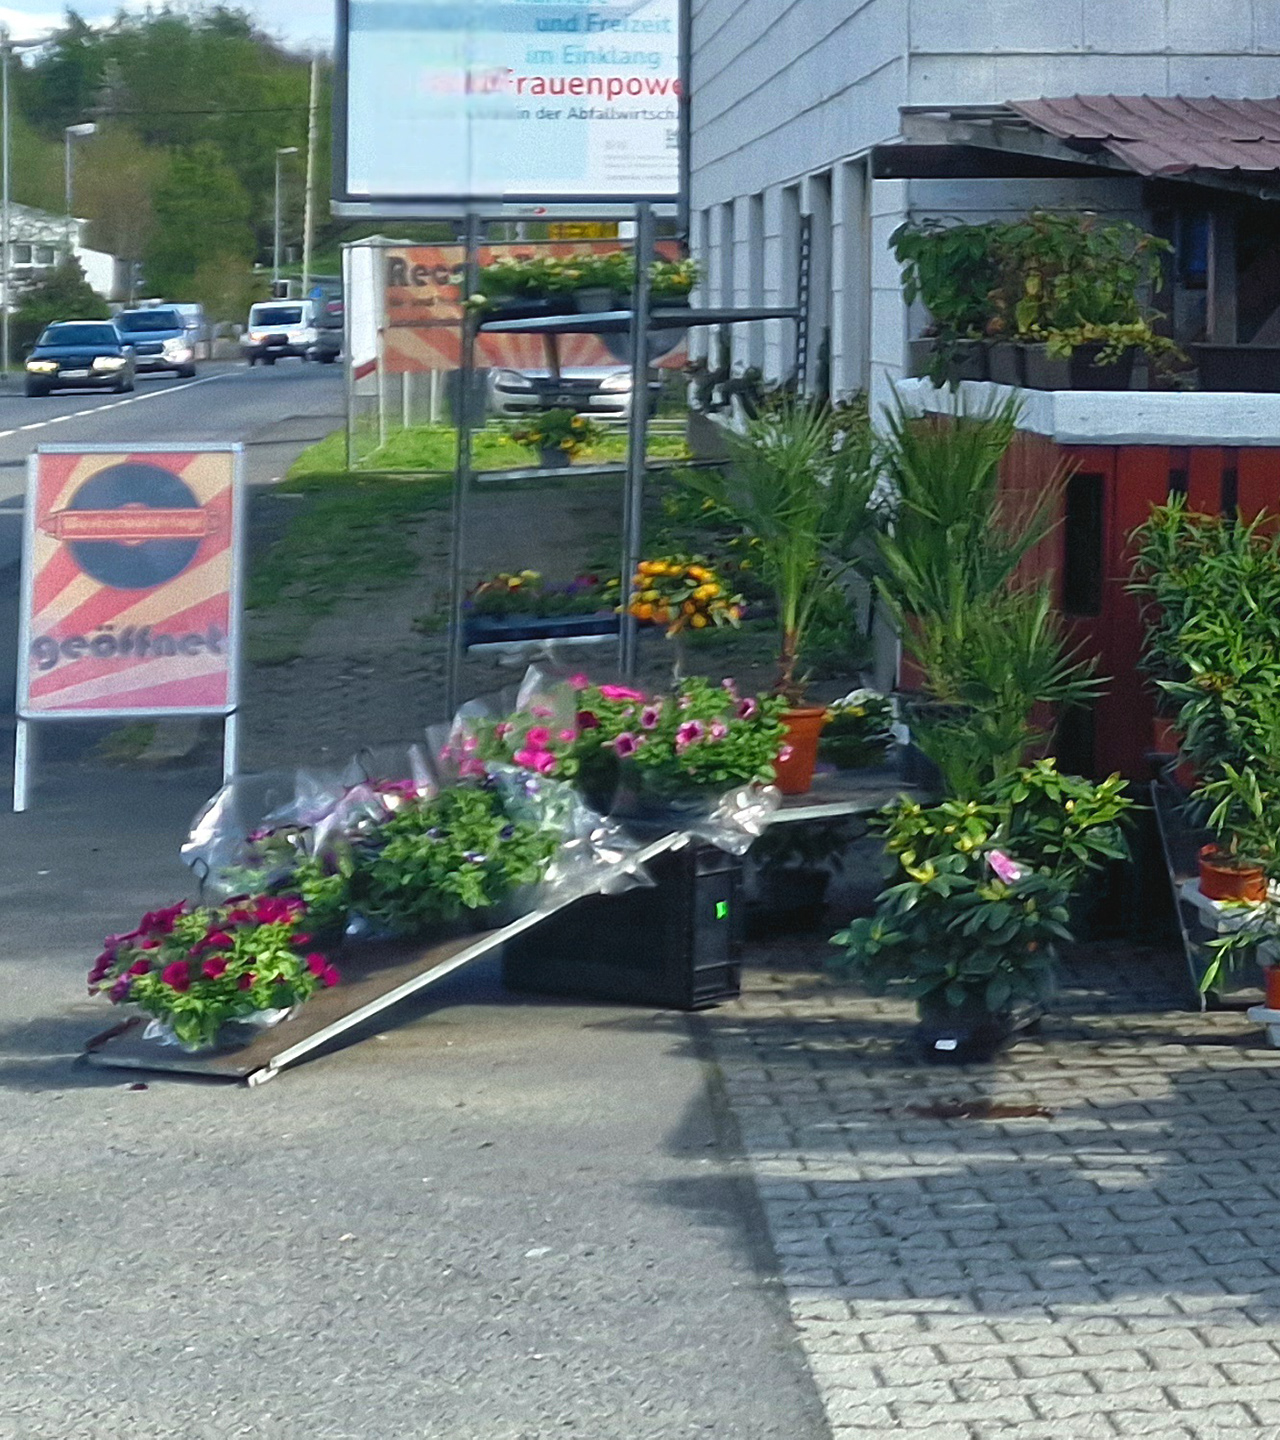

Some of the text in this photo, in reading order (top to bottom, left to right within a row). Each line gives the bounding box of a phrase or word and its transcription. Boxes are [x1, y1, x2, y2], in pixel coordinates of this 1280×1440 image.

[535, 12, 672, 34] und Freizeit
[562, 44, 662, 70] Einklang
[535, 106, 561, 121] der
[29, 623, 223, 671] geöffnet
